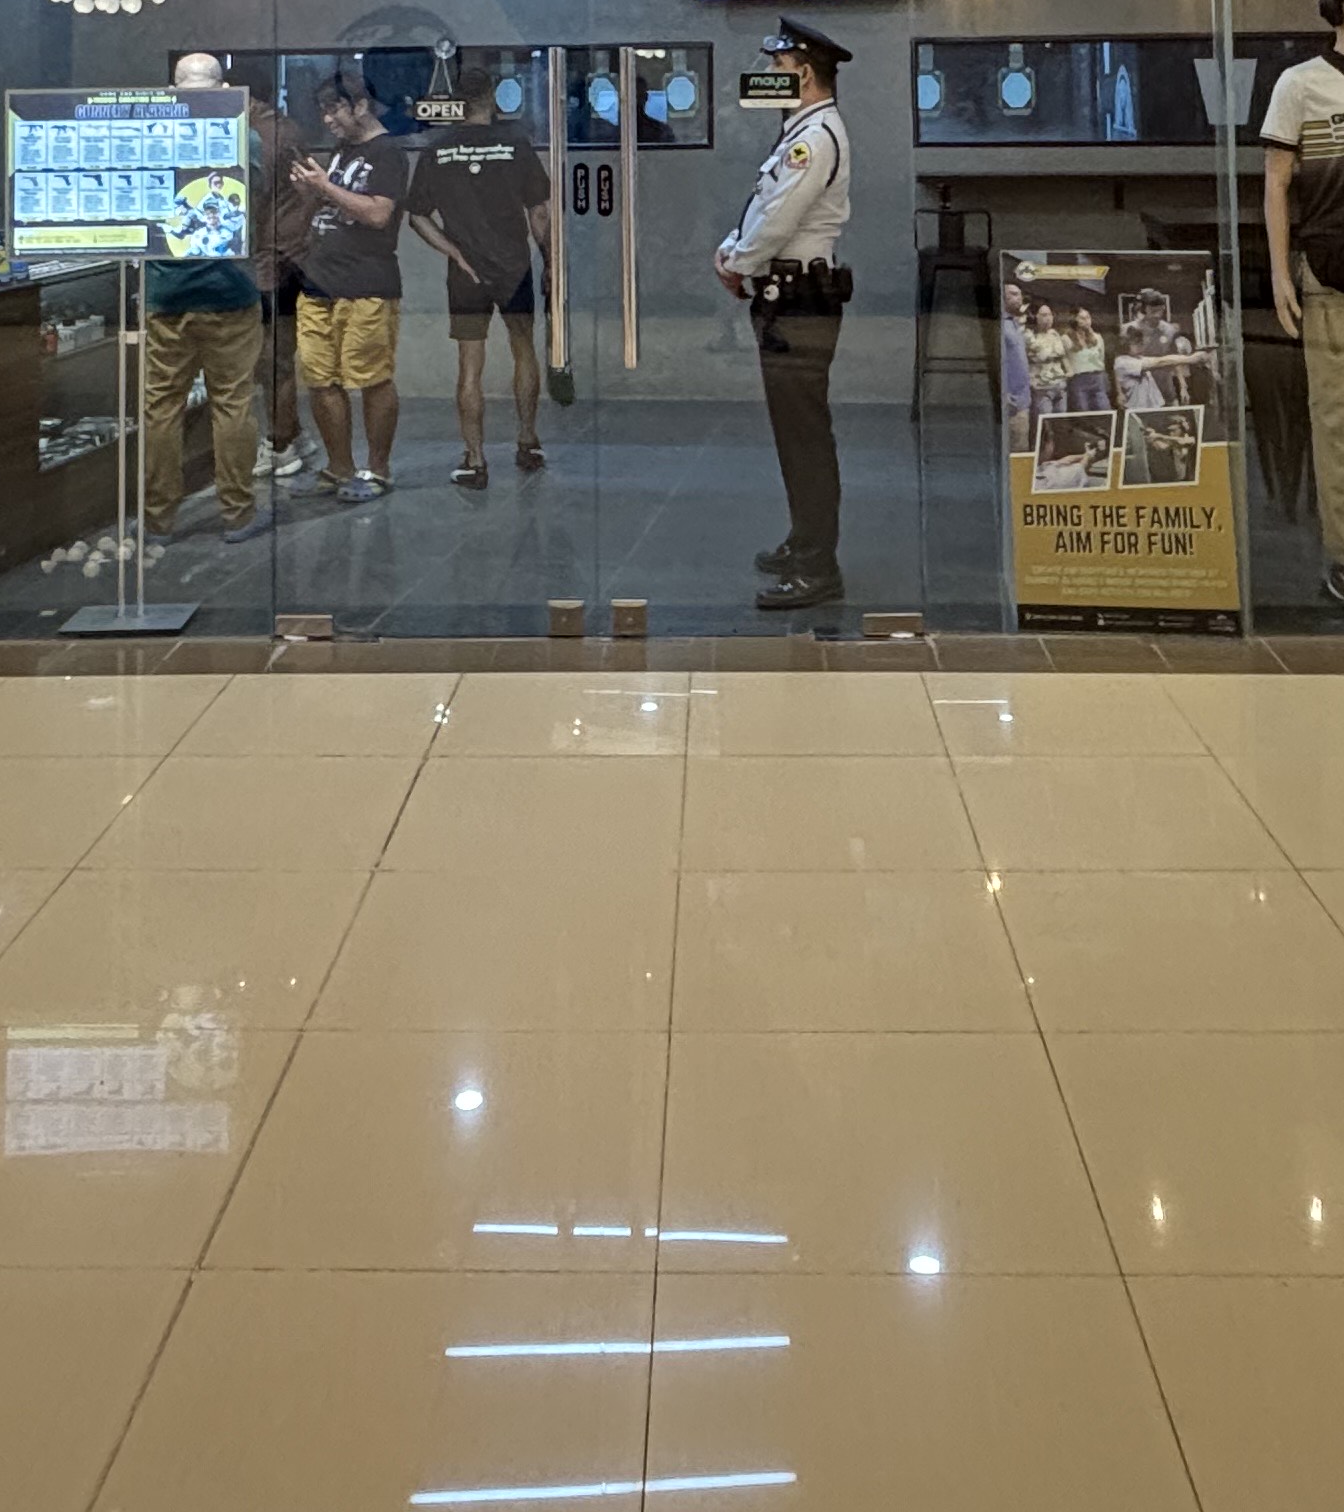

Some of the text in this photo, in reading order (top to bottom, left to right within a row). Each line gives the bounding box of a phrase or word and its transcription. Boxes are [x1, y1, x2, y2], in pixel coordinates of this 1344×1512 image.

[749, 76, 790, 89] maya
[417, 104, 464, 117] OPEN
[577, 169, 586, 209] PUSH
[600, 170, 610, 210] PUSH
[1023, 504, 1223, 532] BRING THE FAMILY,
[1054, 531, 1195, 556] AIM FOR FUN!
